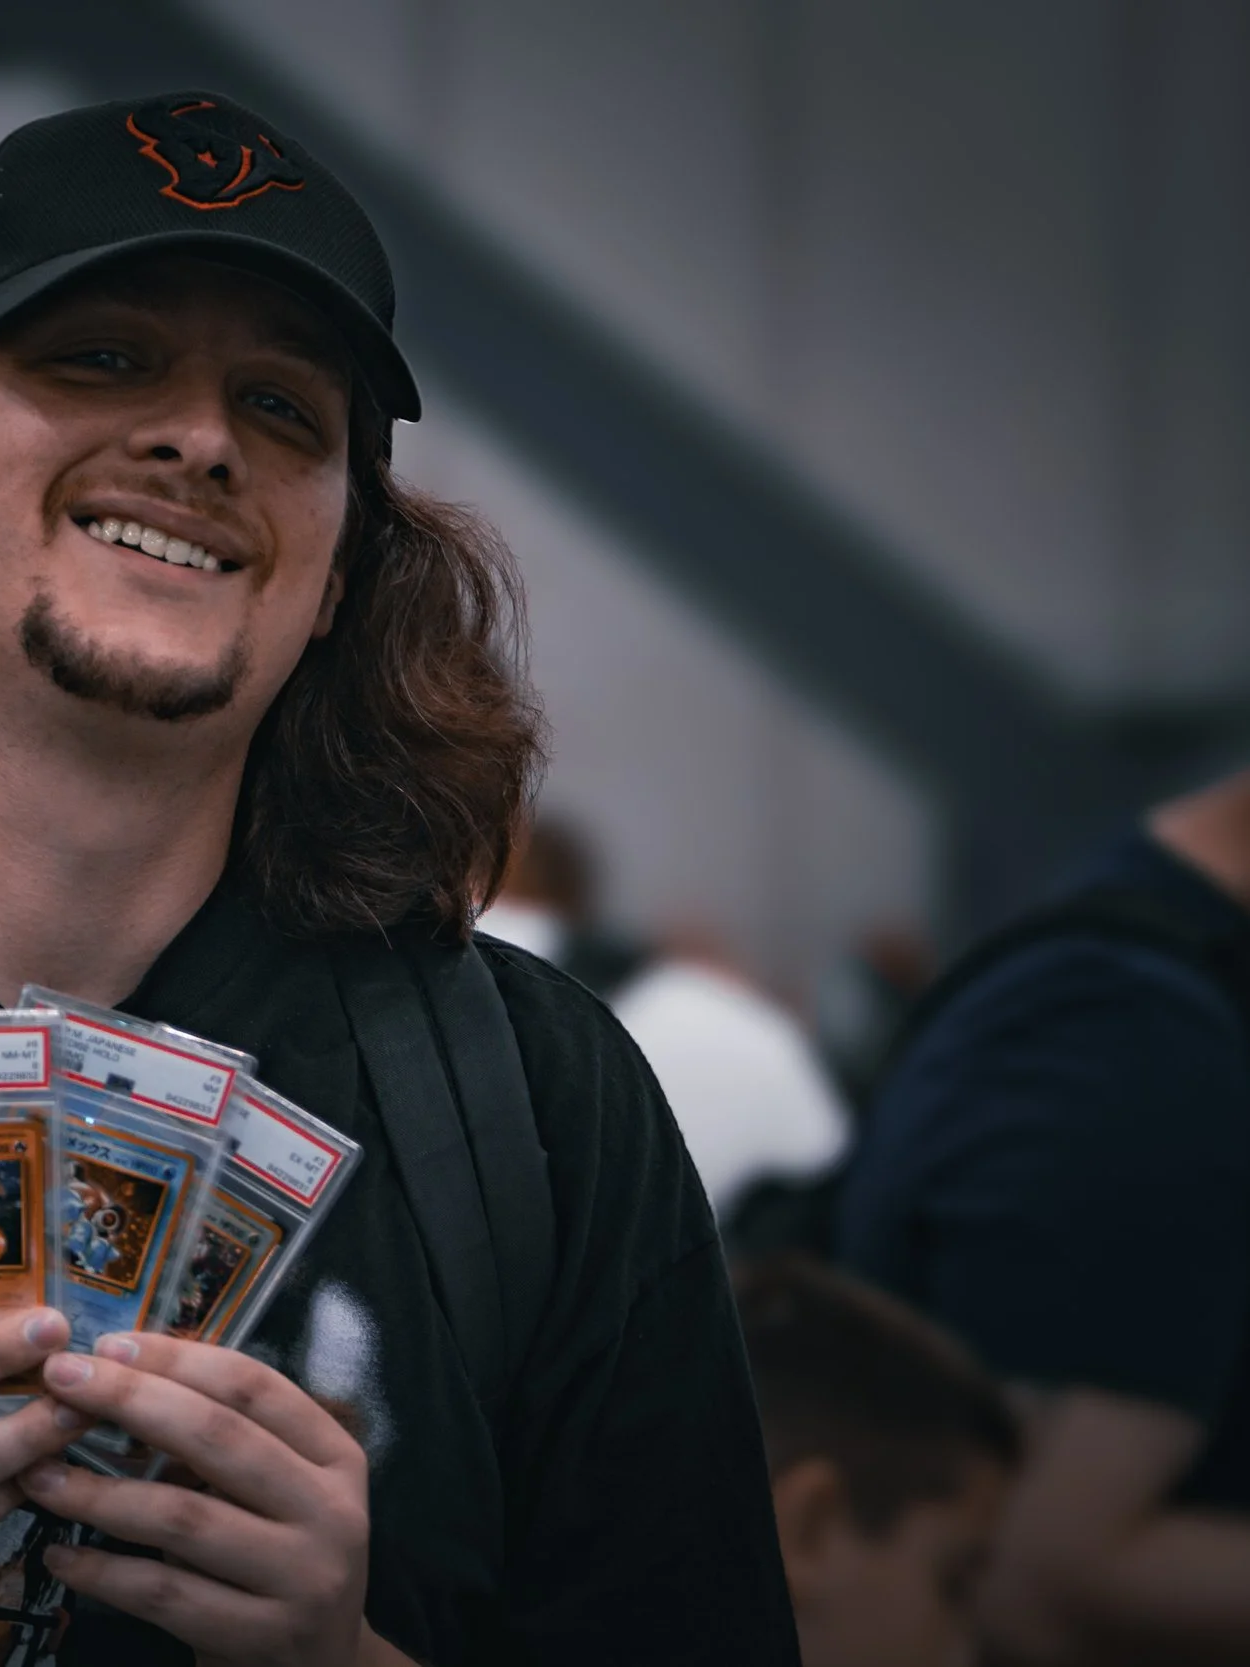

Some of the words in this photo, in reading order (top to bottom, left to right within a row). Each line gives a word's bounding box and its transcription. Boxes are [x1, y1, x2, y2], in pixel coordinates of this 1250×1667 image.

[0, 1049, 38, 1060] NM-MT
[87, 1034, 136, 1057] JAPANESE
[65, 1136, 111, 1161] メックス
